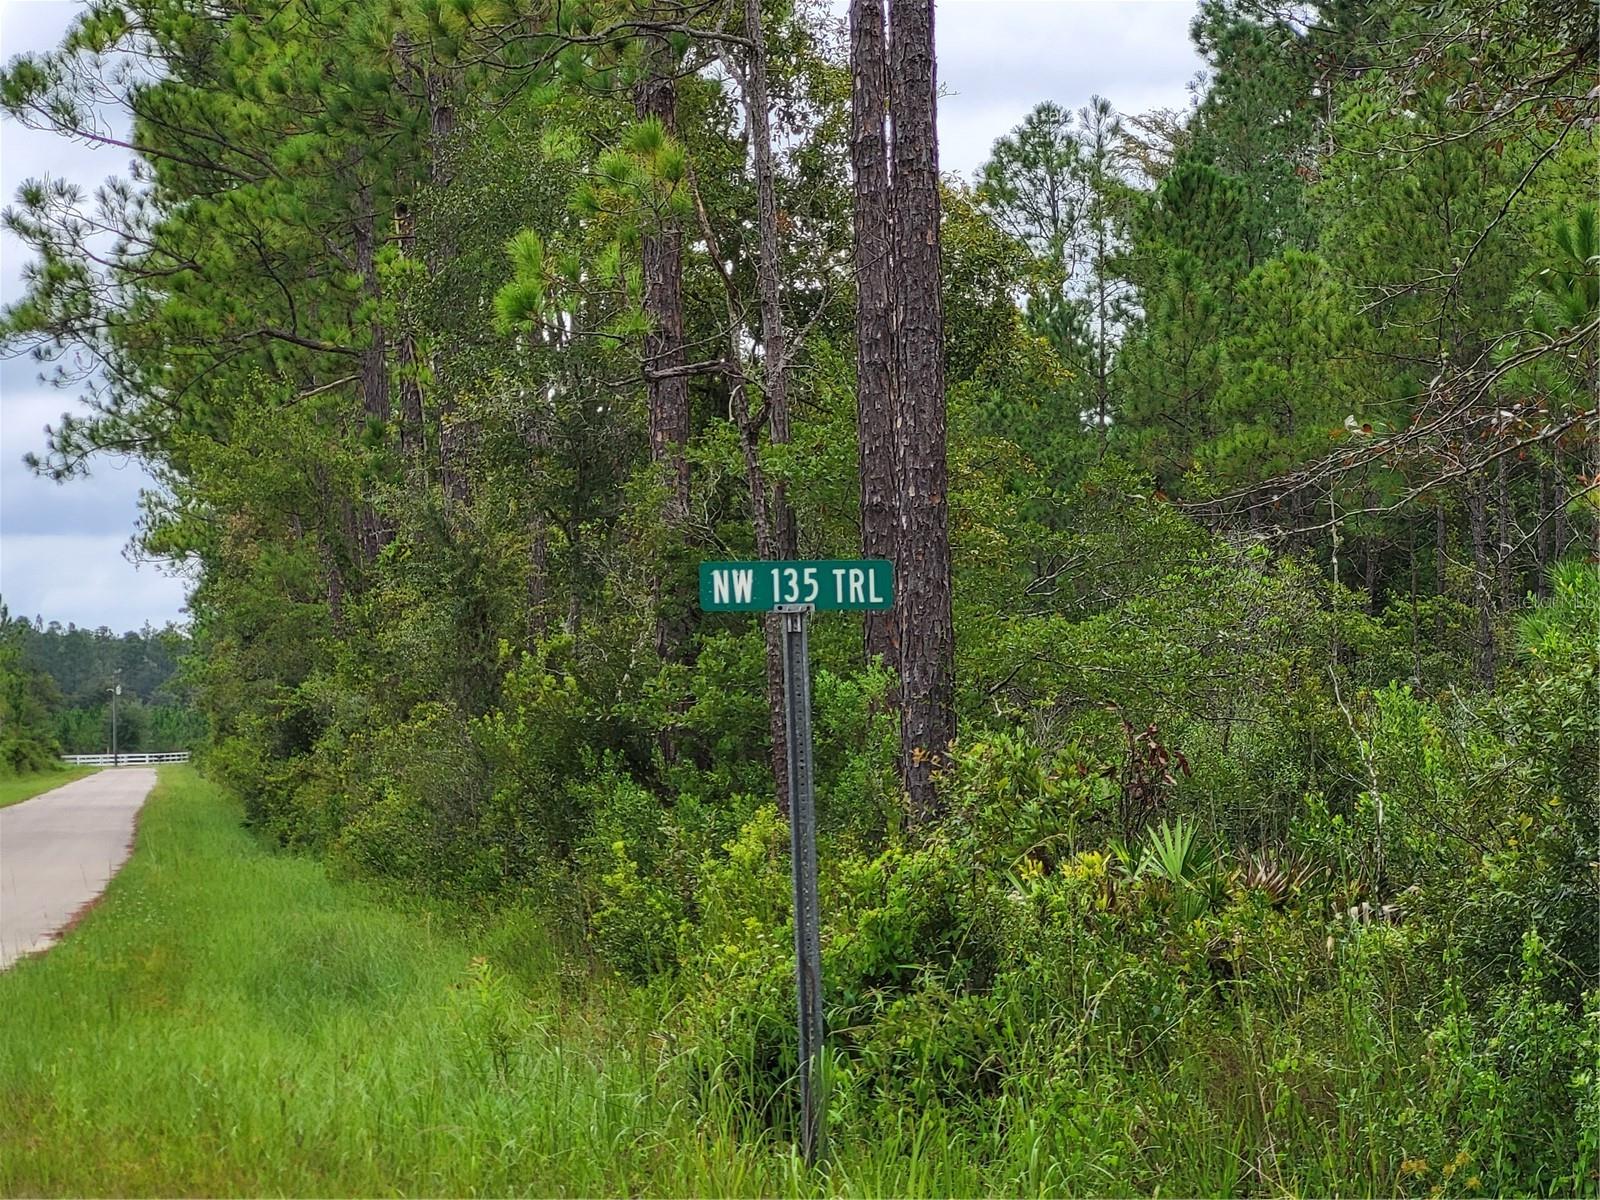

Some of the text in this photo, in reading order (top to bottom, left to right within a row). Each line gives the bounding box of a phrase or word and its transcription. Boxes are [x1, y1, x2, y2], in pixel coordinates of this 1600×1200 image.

[710, 567, 884, 604] NW 135 TRL
